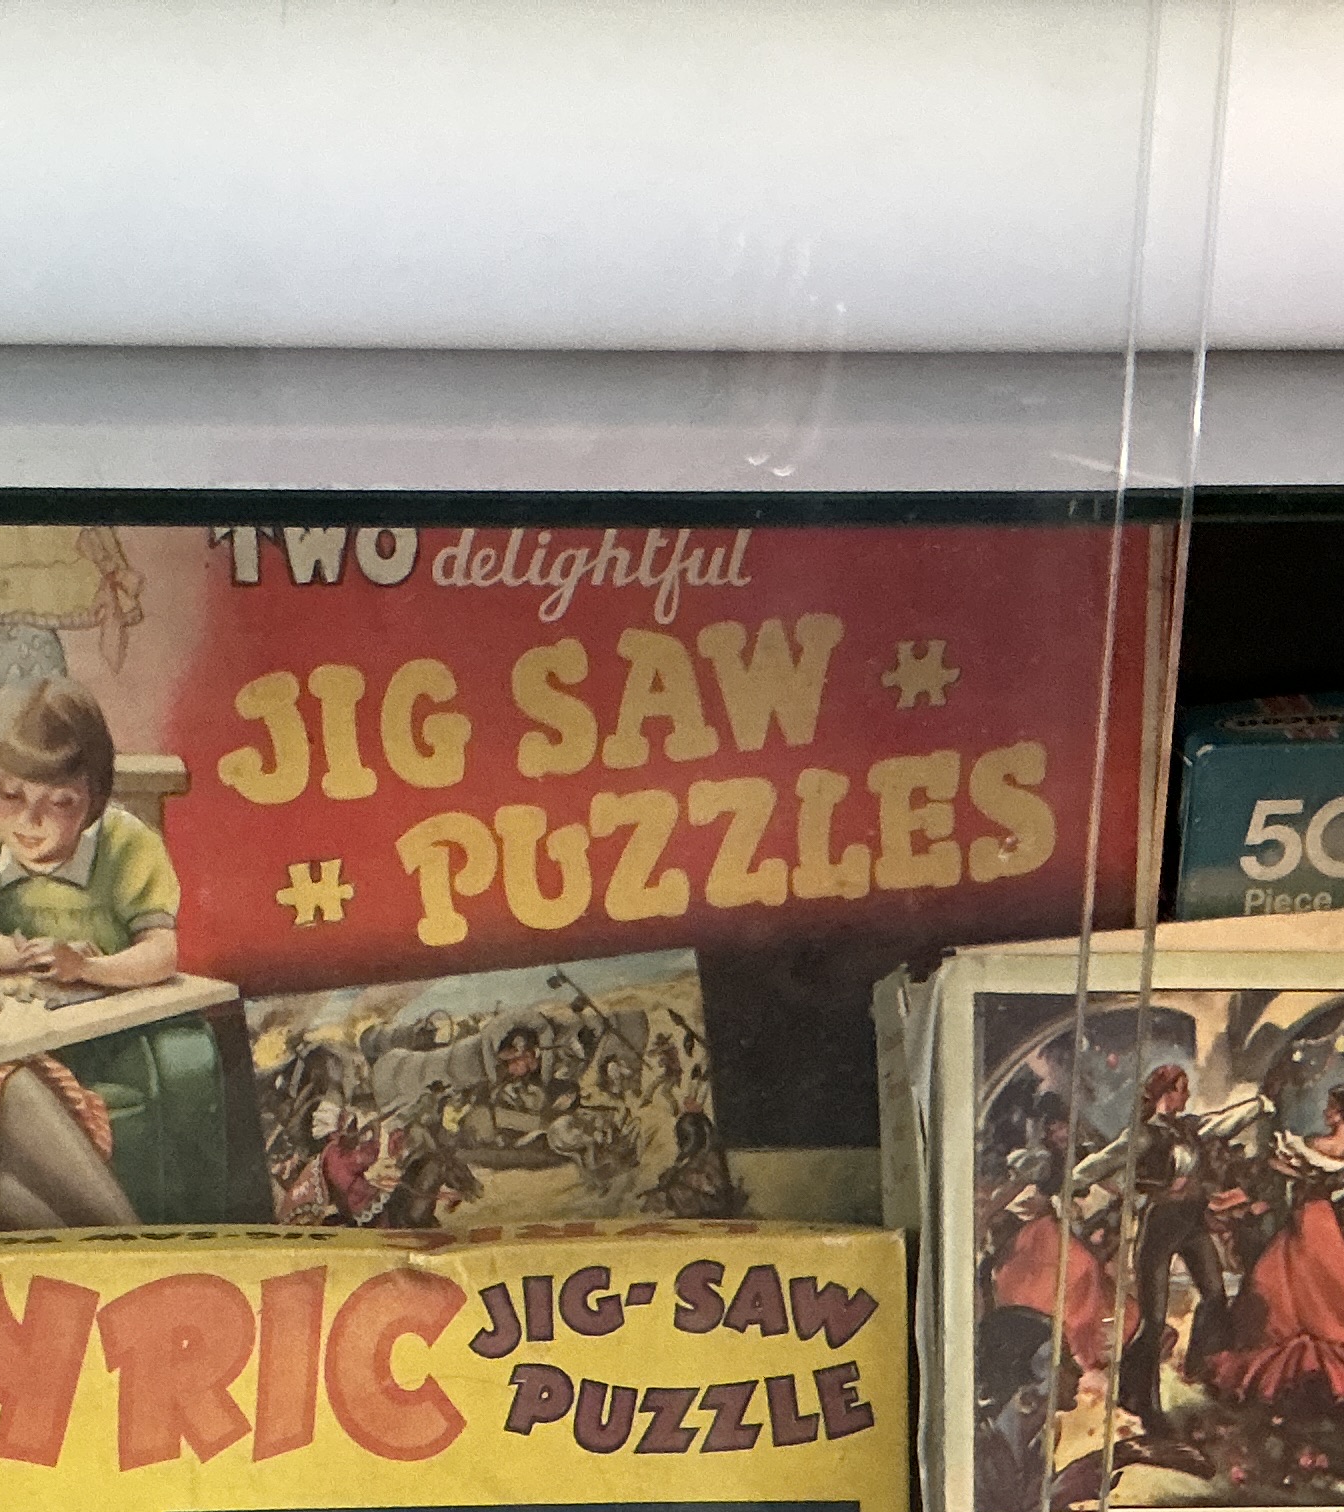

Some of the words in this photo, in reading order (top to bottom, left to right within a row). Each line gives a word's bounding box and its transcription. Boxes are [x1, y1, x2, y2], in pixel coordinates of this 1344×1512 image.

[208, 526, 419, 586] TWO
[433, 527, 752, 623] delightful
[218, 659, 472, 805] JIG
[512, 614, 844, 778] SAW
[395, 741, 1056, 948] PUZZLES
[1244, 885, 1332, 915] Piece
[468, 1259, 879, 1358] JIG-SAW
[502, 1361, 875, 1456] PUZZLE
